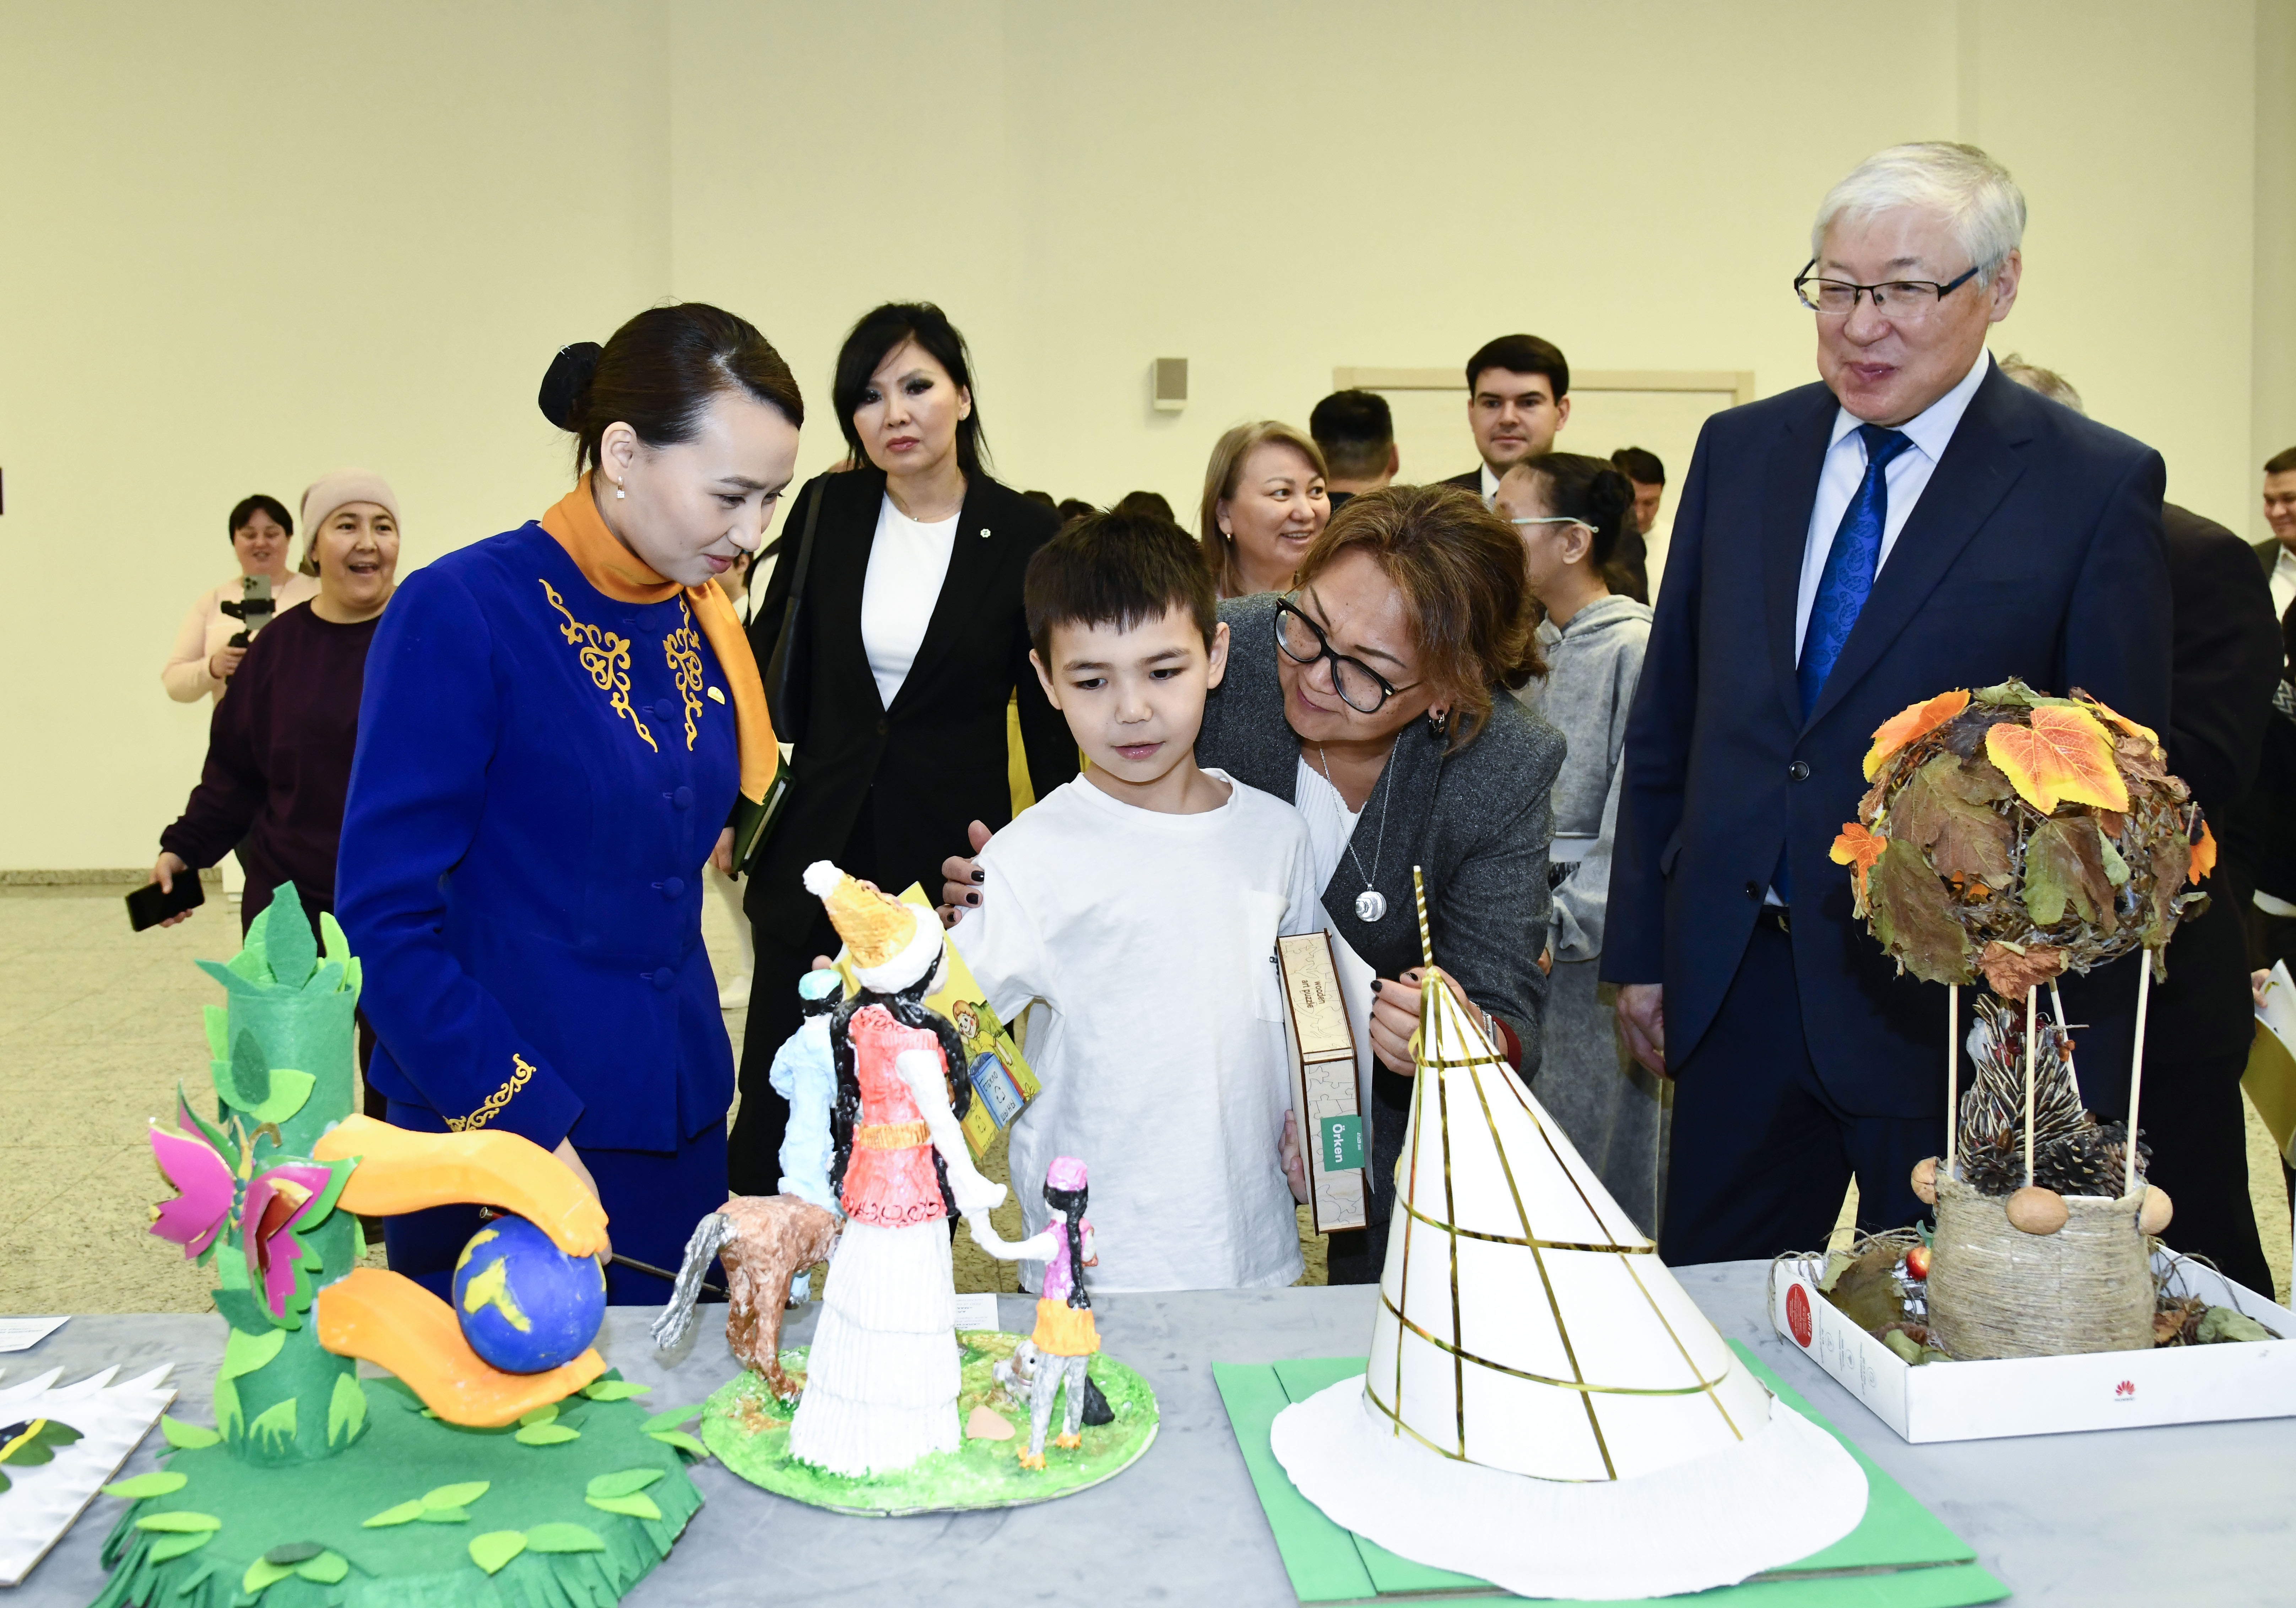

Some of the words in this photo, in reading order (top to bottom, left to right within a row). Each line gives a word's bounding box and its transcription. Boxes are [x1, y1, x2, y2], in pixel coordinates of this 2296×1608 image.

[1301, 989, 1315, 1008] puzzle
[1314, 980, 1325, 1004] wooden
[983, 1071, 998, 1092] СТЕКЛО
[1000, 1098, 1016, 1121] ШЫНЫ
[1333, 1124, 1345, 1163] Örken
